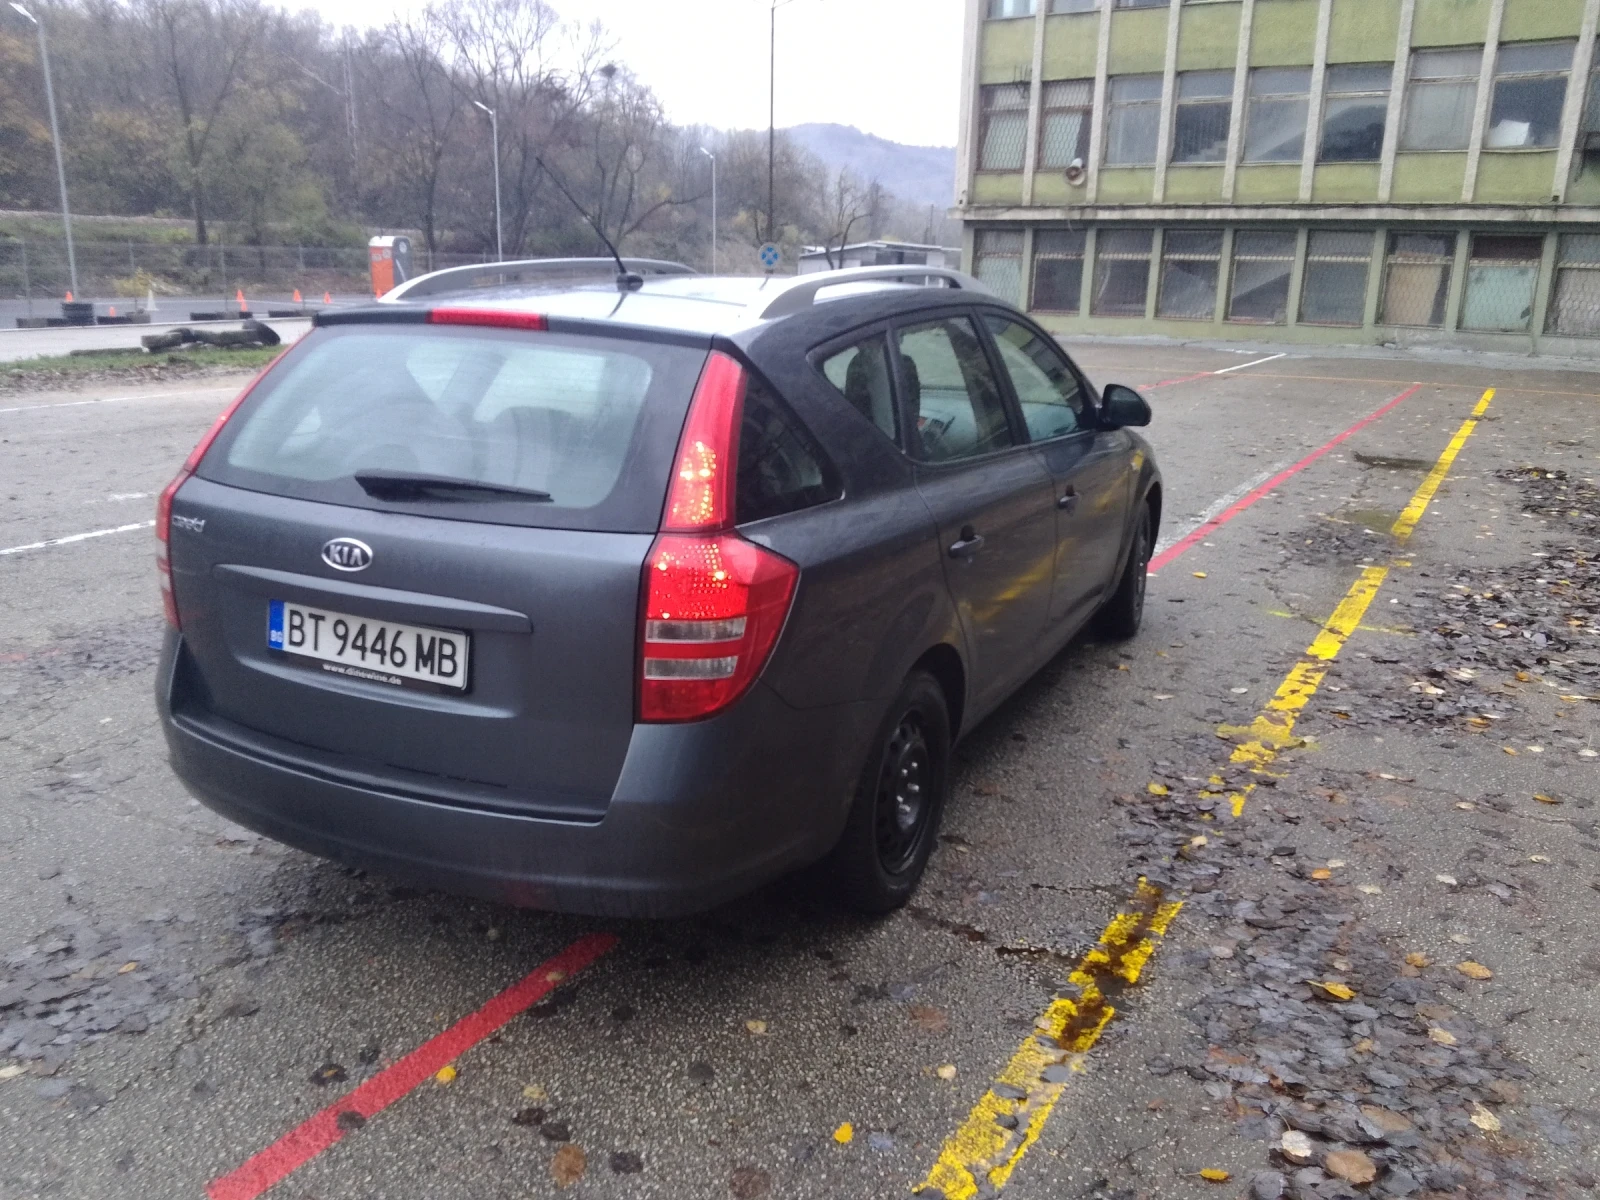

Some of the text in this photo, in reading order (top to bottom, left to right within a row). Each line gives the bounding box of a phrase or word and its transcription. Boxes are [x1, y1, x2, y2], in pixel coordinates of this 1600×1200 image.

[329, 544, 363, 566] KIA
[289, 609, 458, 679] BT 9446 MB
